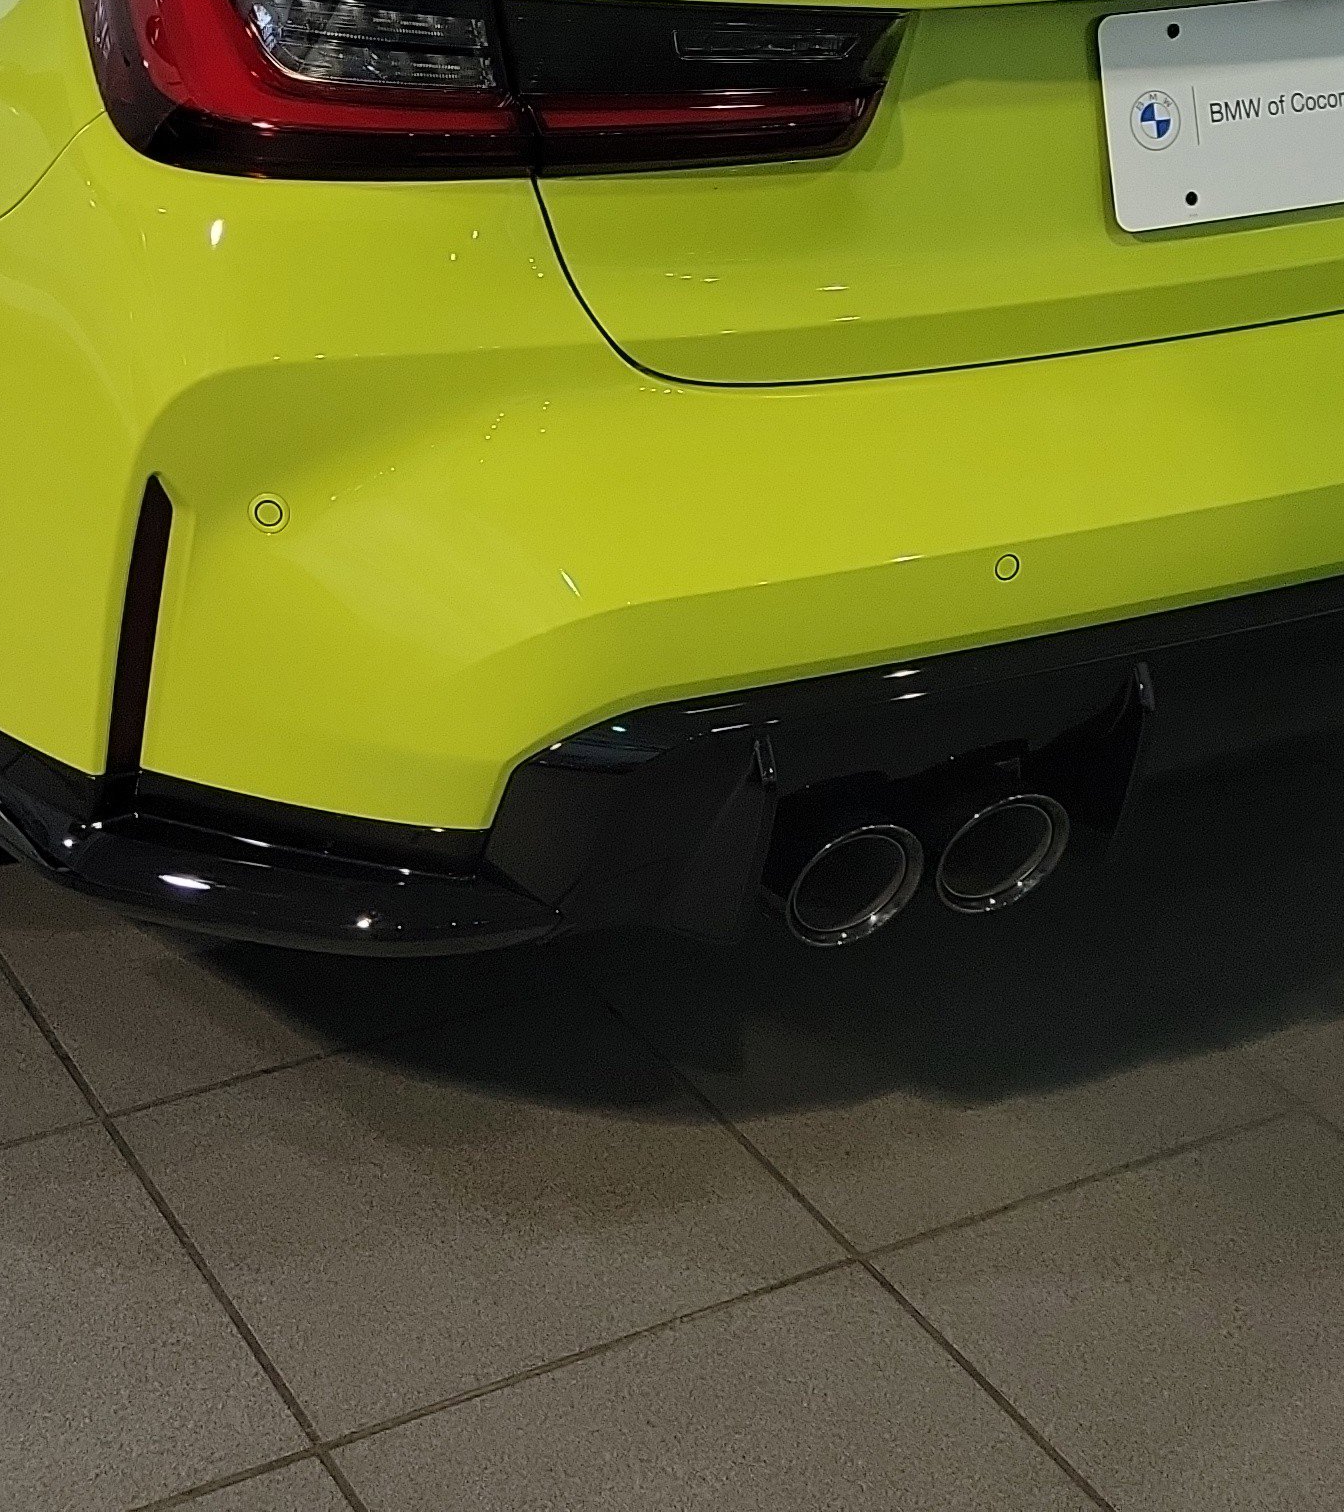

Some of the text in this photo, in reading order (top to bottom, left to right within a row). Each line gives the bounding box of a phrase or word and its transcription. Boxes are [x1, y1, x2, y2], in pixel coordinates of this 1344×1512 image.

[1136, 93, 1172, 111] BMW
[1209, 98, 1261, 123] BMW
[1267, 95, 1286, 116] of
